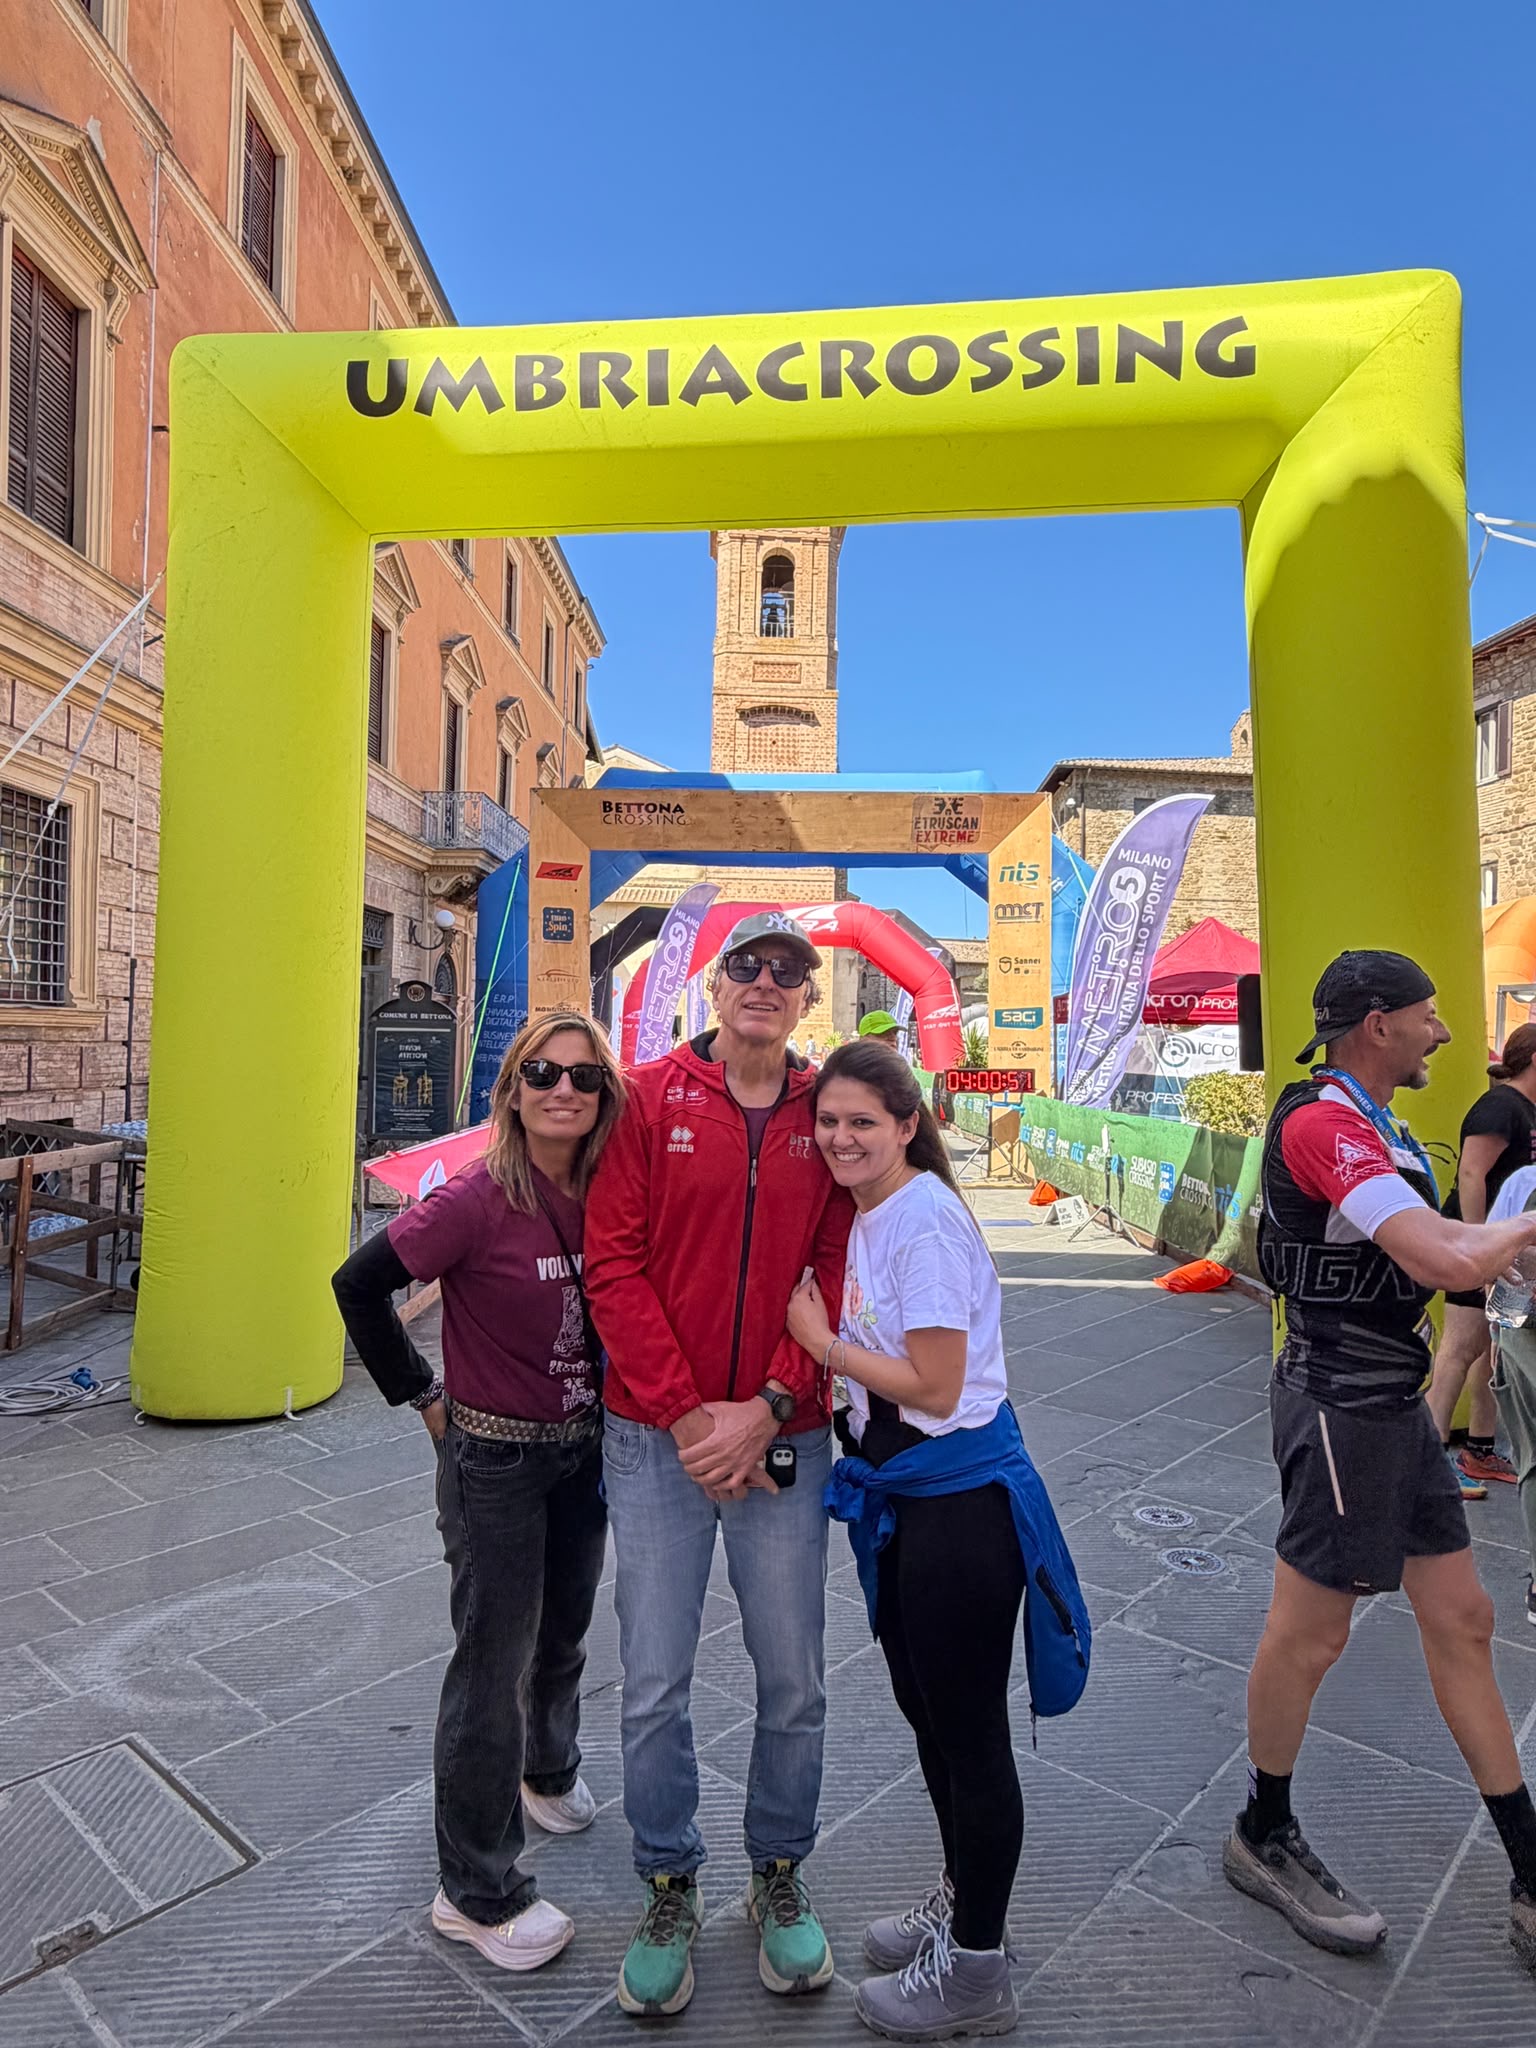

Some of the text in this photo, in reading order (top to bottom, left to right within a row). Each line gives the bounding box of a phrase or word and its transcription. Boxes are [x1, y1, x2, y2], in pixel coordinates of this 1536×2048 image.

[346, 315, 1257, 418] UMBRIACROSSING
[602, 800, 685, 814] BETTONA
[602, 813, 687, 826] CROSSING
[914, 816, 978, 831] ETRUSCAN
[915, 829, 976, 843] EXTREME
[1118, 848, 1172, 870] MILANO
[675, 909, 701, 929] MILANO
[1130, 929, 1150, 978] DELLO
[1144, 873, 1168, 925] SPORT
[683, 929, 698, 965] SPORT
[947, 1071, 1032, 1091] 04:00:51
[1339, 1075, 1373, 1113] FINISHER
[1130, 1155, 1157, 1177] SUBASIO
